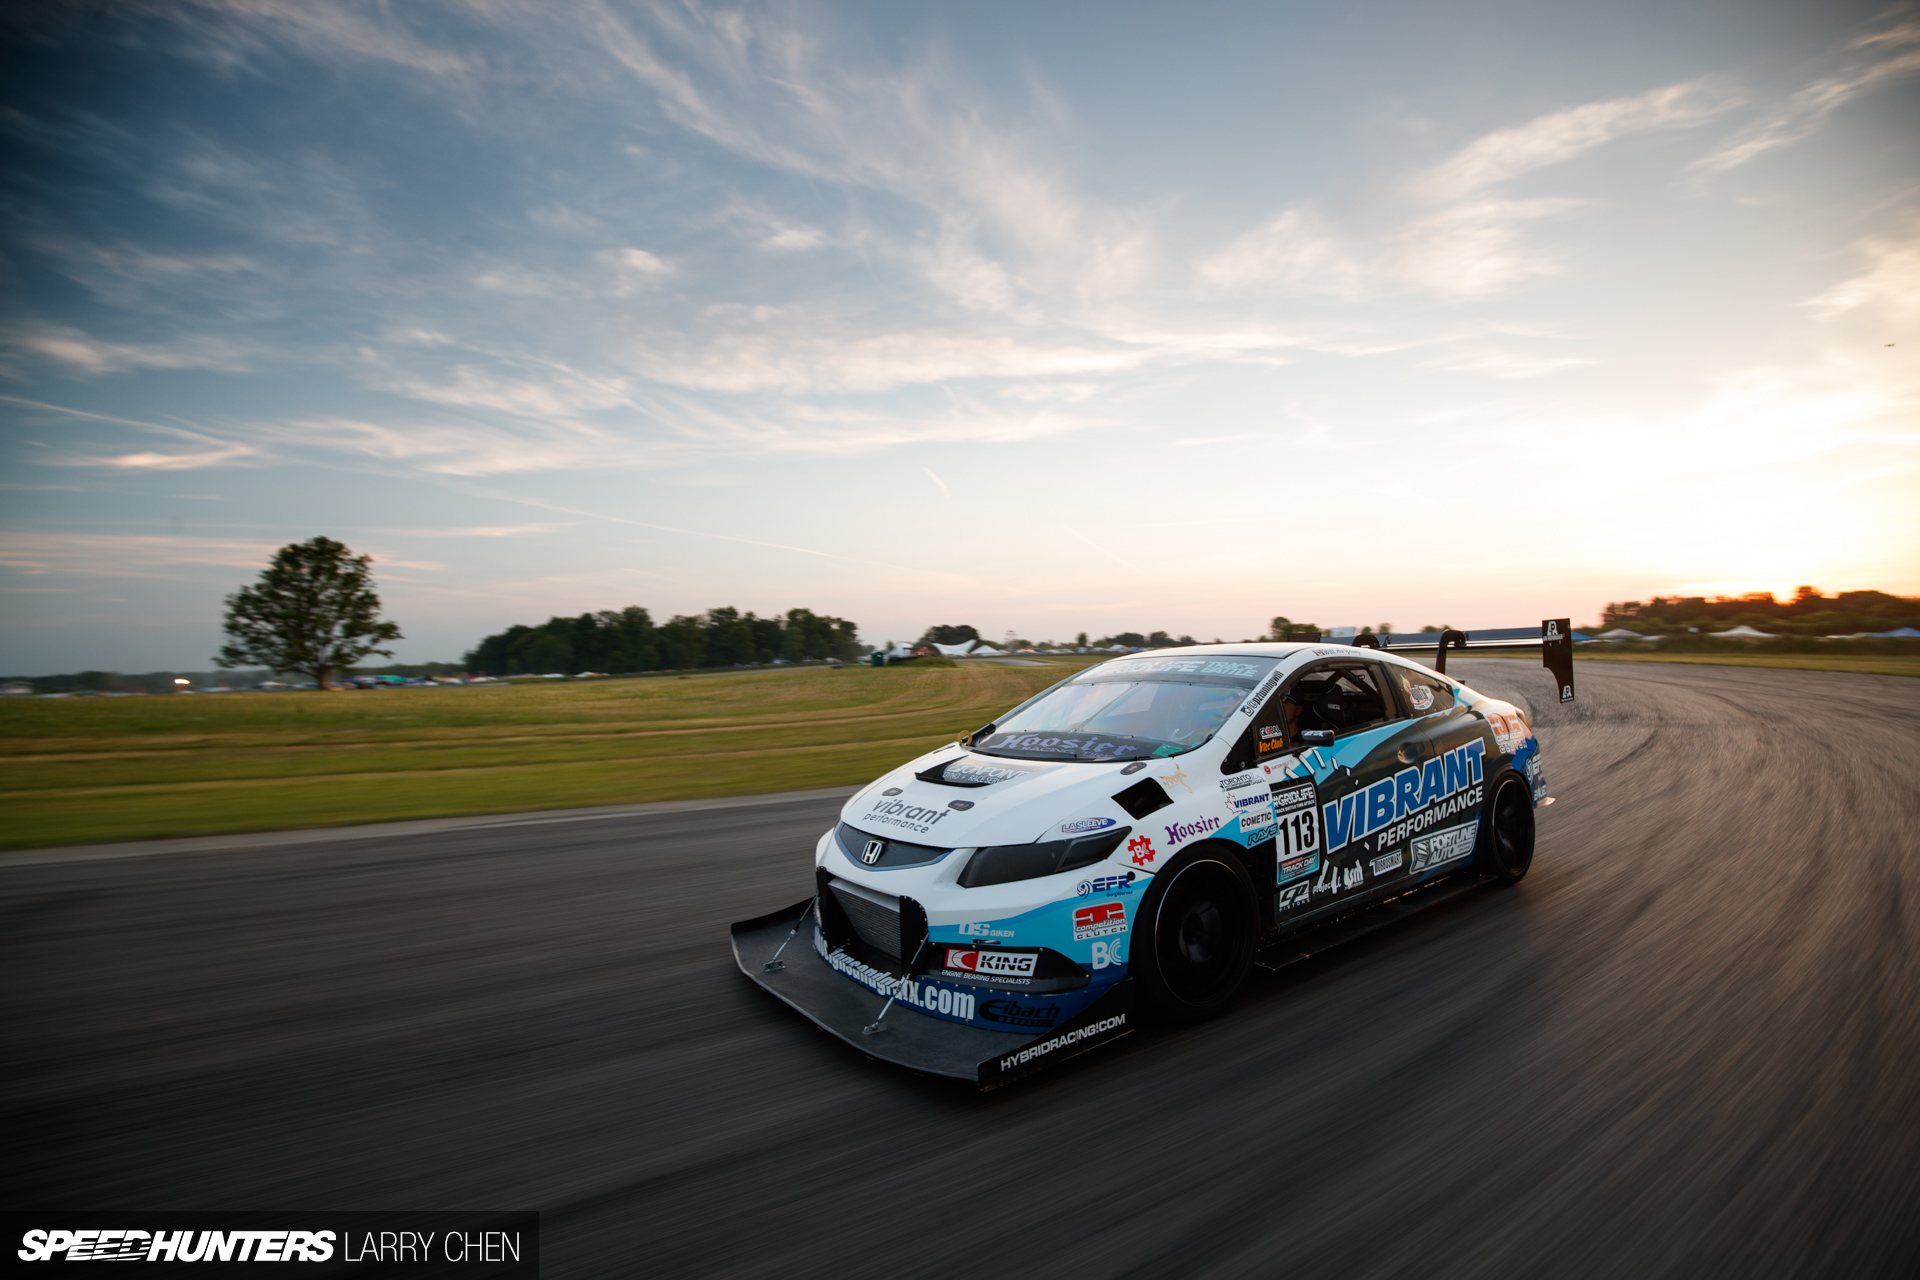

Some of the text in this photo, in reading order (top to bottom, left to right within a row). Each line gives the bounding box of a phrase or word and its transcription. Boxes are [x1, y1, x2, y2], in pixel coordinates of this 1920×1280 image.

[990, 734, 1138, 756] Hoosier
[1021, 746, 1076, 754] RACING
[1219, 773, 1252, 788] TORONTO
[1233, 793, 1270, 809] VIBRANT
[1322, 736, 1486, 855] VIBRANT
[872, 799, 951, 825] vibrant
[1241, 811, 1272, 828] COMETIC
[1378, 786, 1483, 852] PERFORMANCE
[862, 813, 929, 834] performance
[1164, 816, 1221, 846] Hoosier
[1247, 822, 1279, 847] RAYS
[1280, 810, 1315, 856] 113
[1430, 825, 1476, 853] FORTUNE
[1428, 845, 1455, 866] AUTO
[1282, 861, 1304, 874] TRACK
[1093, 875, 1132, 892] EFR
[1279, 898, 1310, 912] PISTONS
[990, 928, 1016, 938] GIKEN
[1076, 917, 1126, 933] competition
[1077, 926, 1126, 939] CLUTCH
[980, 955, 1033, 972] KING
[941, 969, 1031, 985] ENGINE BEARING SPECIALISTS
[979, 999, 1060, 1023] Eibach
